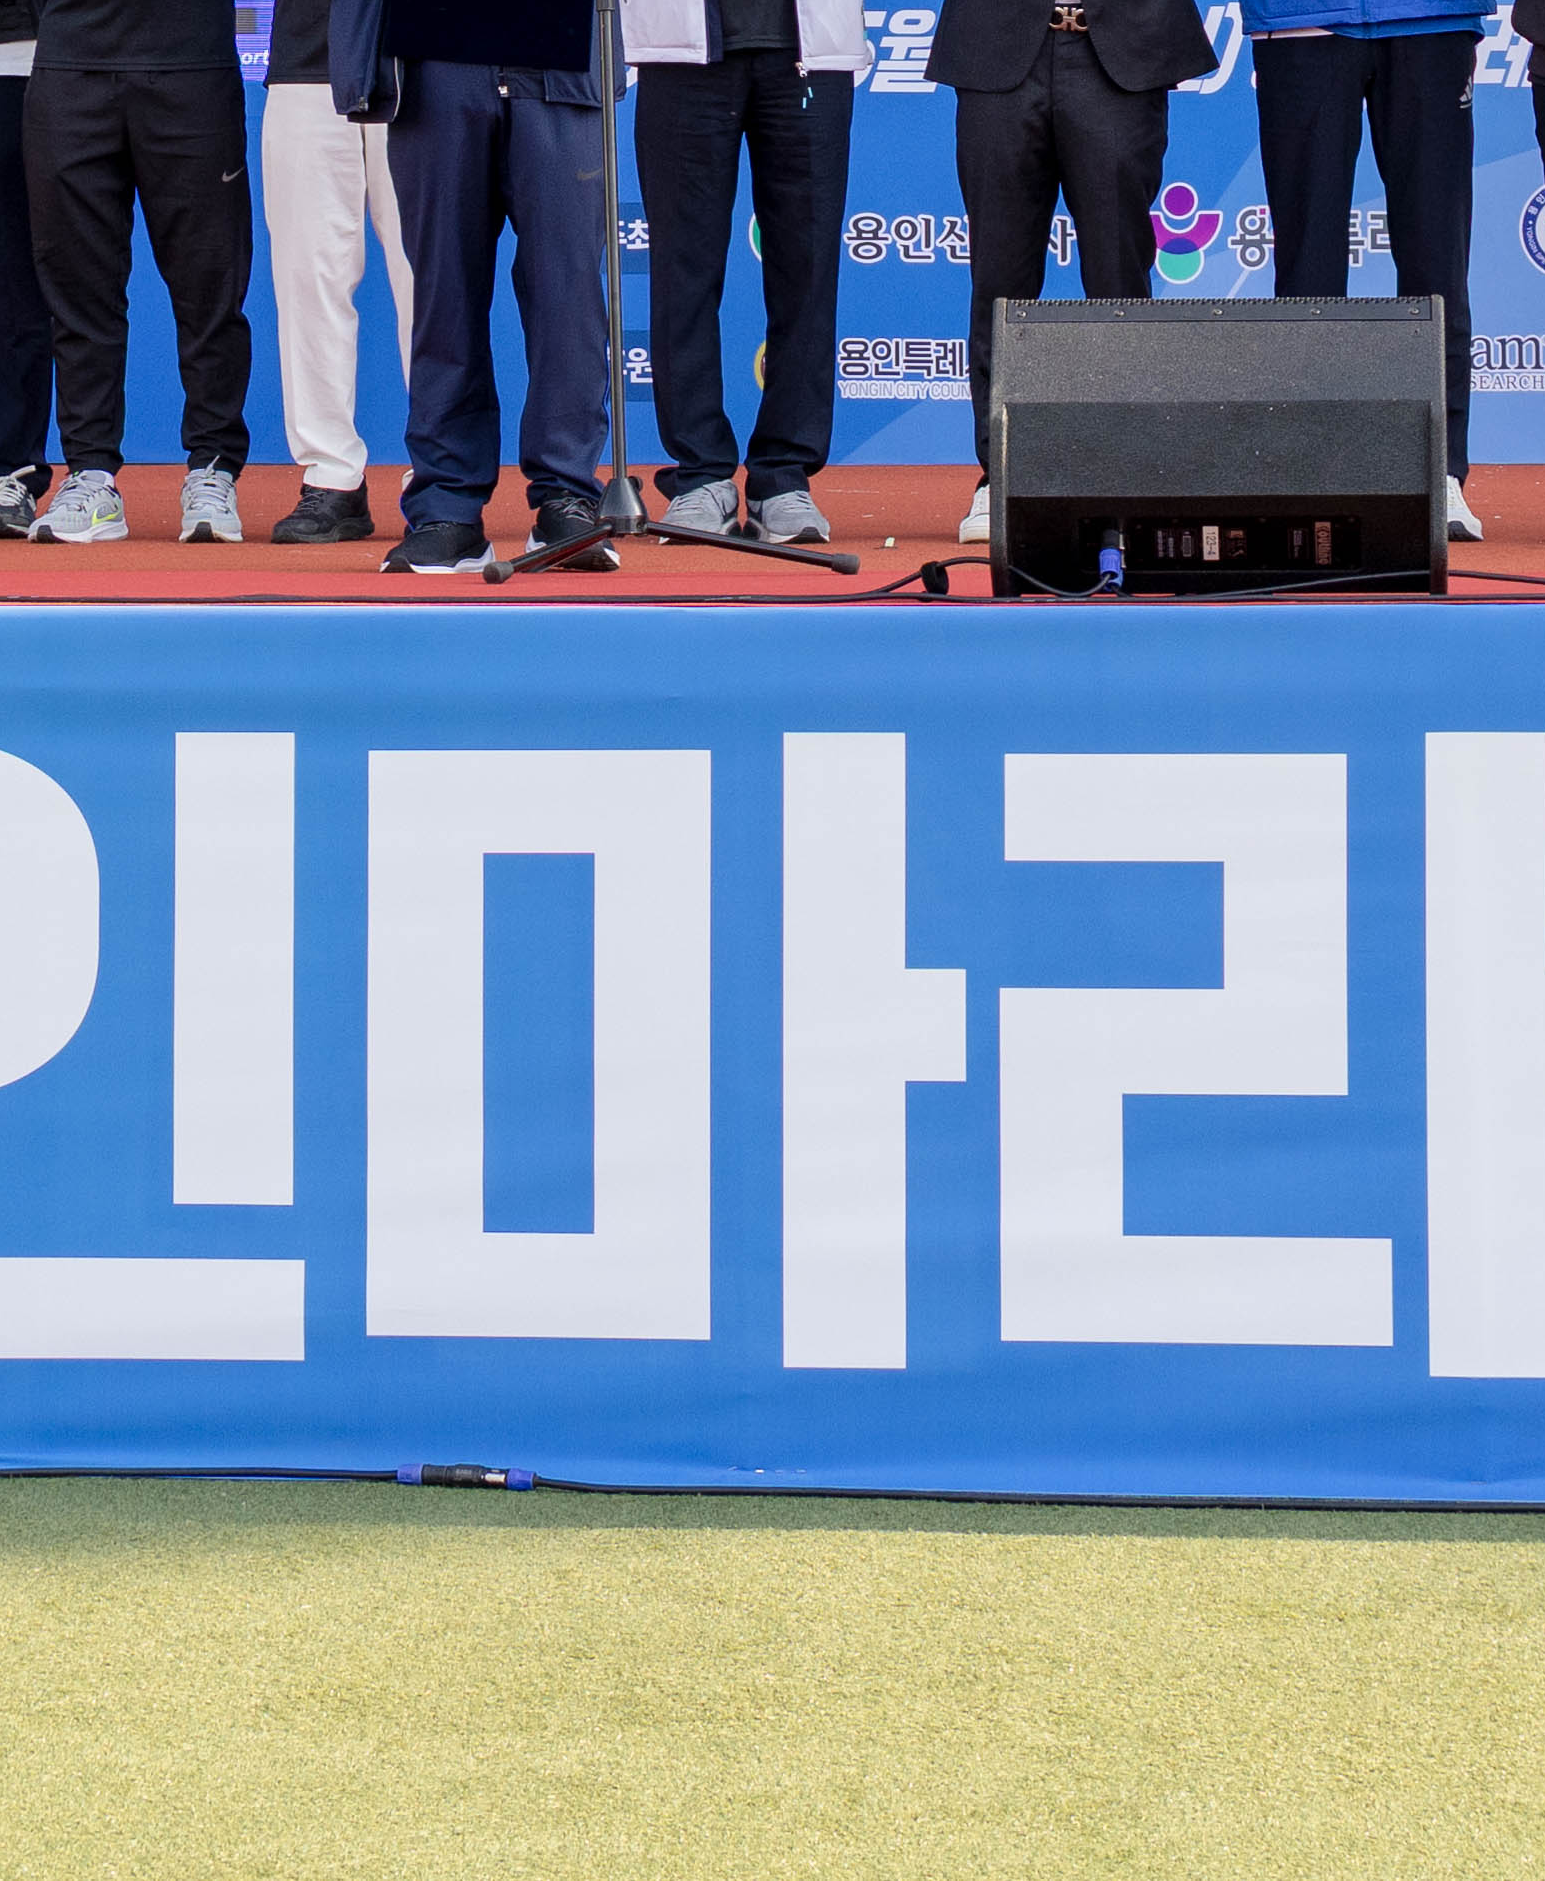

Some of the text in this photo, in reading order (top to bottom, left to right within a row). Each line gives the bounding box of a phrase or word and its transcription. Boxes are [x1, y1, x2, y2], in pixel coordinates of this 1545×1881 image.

[840, 381, 895, 400] YONGIN
[896, 381, 929, 400] CITY
[1206, 530, 1217, 557] 123-4
